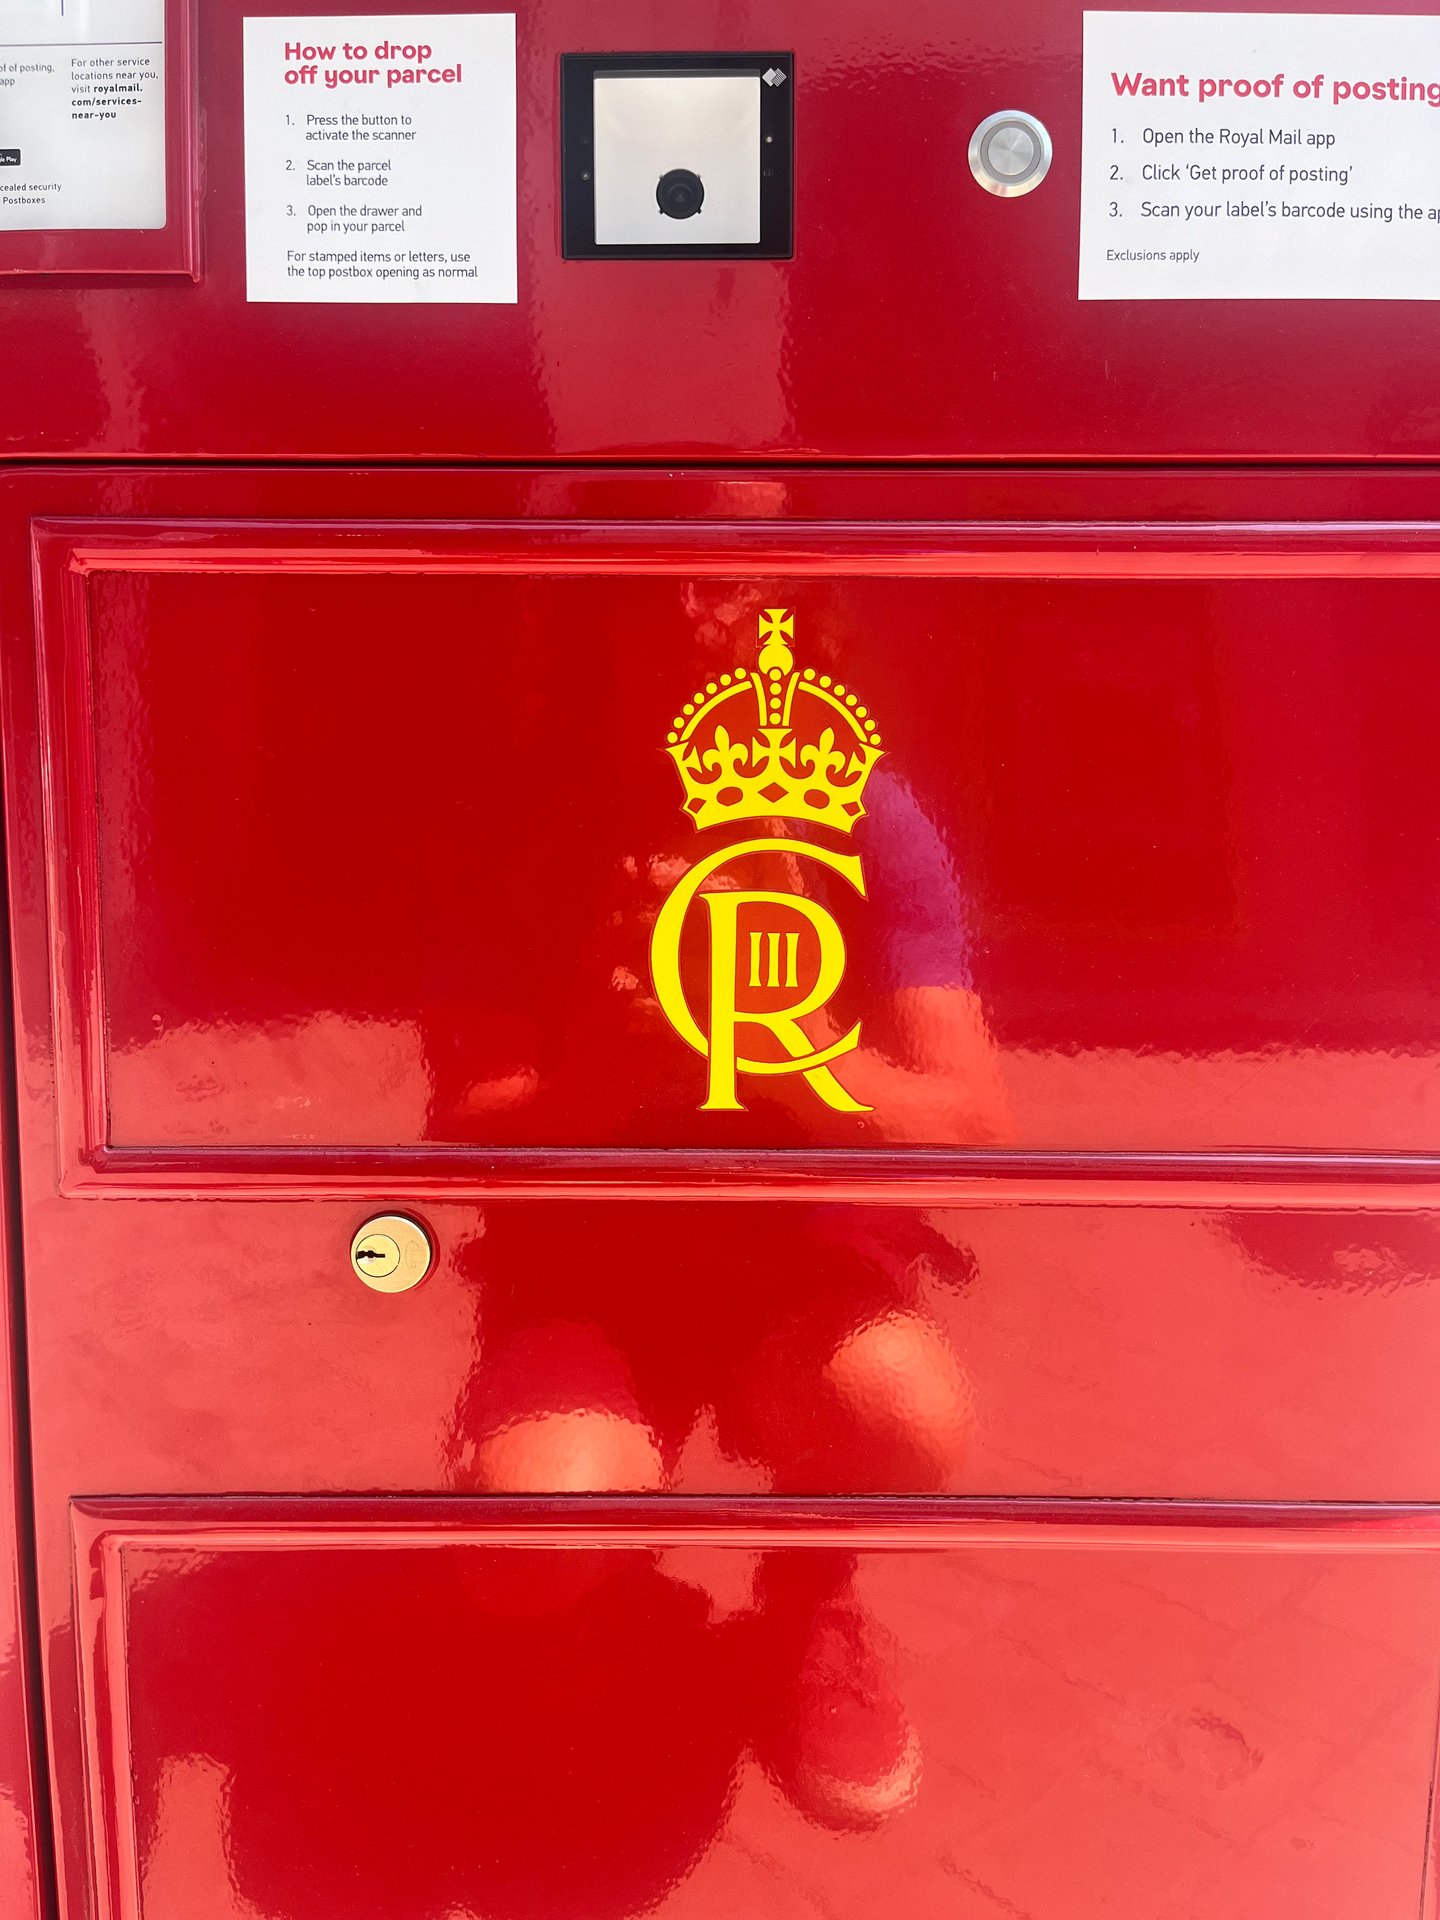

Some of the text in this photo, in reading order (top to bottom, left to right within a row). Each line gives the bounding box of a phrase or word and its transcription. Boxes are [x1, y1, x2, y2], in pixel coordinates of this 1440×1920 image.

[285, 41, 432, 63] How to drop
[9, 64, 17, 72] of
[20, 64, 54, 73] posting,
[72, 59, 86, 67] For
[90, 58, 114, 66] other
[0, 79, 15, 87] app
[72, 72, 113, 80] locations
[140, 72, 158, 81] you,
[285, 64, 461, 89] off your parcel
[72, 83, 142, 94] visit royalmail.
[1111, 73, 1440, 107] Want proof of posting
[72, 97, 141, 106] com/services-
[72, 112, 116, 120] near-you
[286, 114, 411, 125] 1. Press the button to
[306, 129, 416, 140] activate the scanner
[1113, 128, 1335, 149] 1. Open the Royal Mail app
[286, 160, 391, 173] 2. Scan the parcel
[307, 174, 388, 185] label’s barcode
[1110, 164, 1352, 185] 2. Click ‘Get proof of posting’
[29, 184, 61, 192] security
[287, 205, 422, 218] 3. Open the drawer and
[1109, 202, 1122, 217] 3.
[1141, 202, 1179, 217] Scan
[1185, 205, 1221, 221] your
[1227, 201, 1276, 217] label’s
[1282, 201, 1345, 217] barcode
[1351, 203, 1392, 222] using
[1399, 204, 1423, 219] the
[307, 220, 404, 234] pop in your parcel
[288, 251, 470, 264] For stamped items or letters, use
[1107, 249, 1199, 263] Exclusions apply
[288, 266, 478, 280] the top postbox opening as normal
